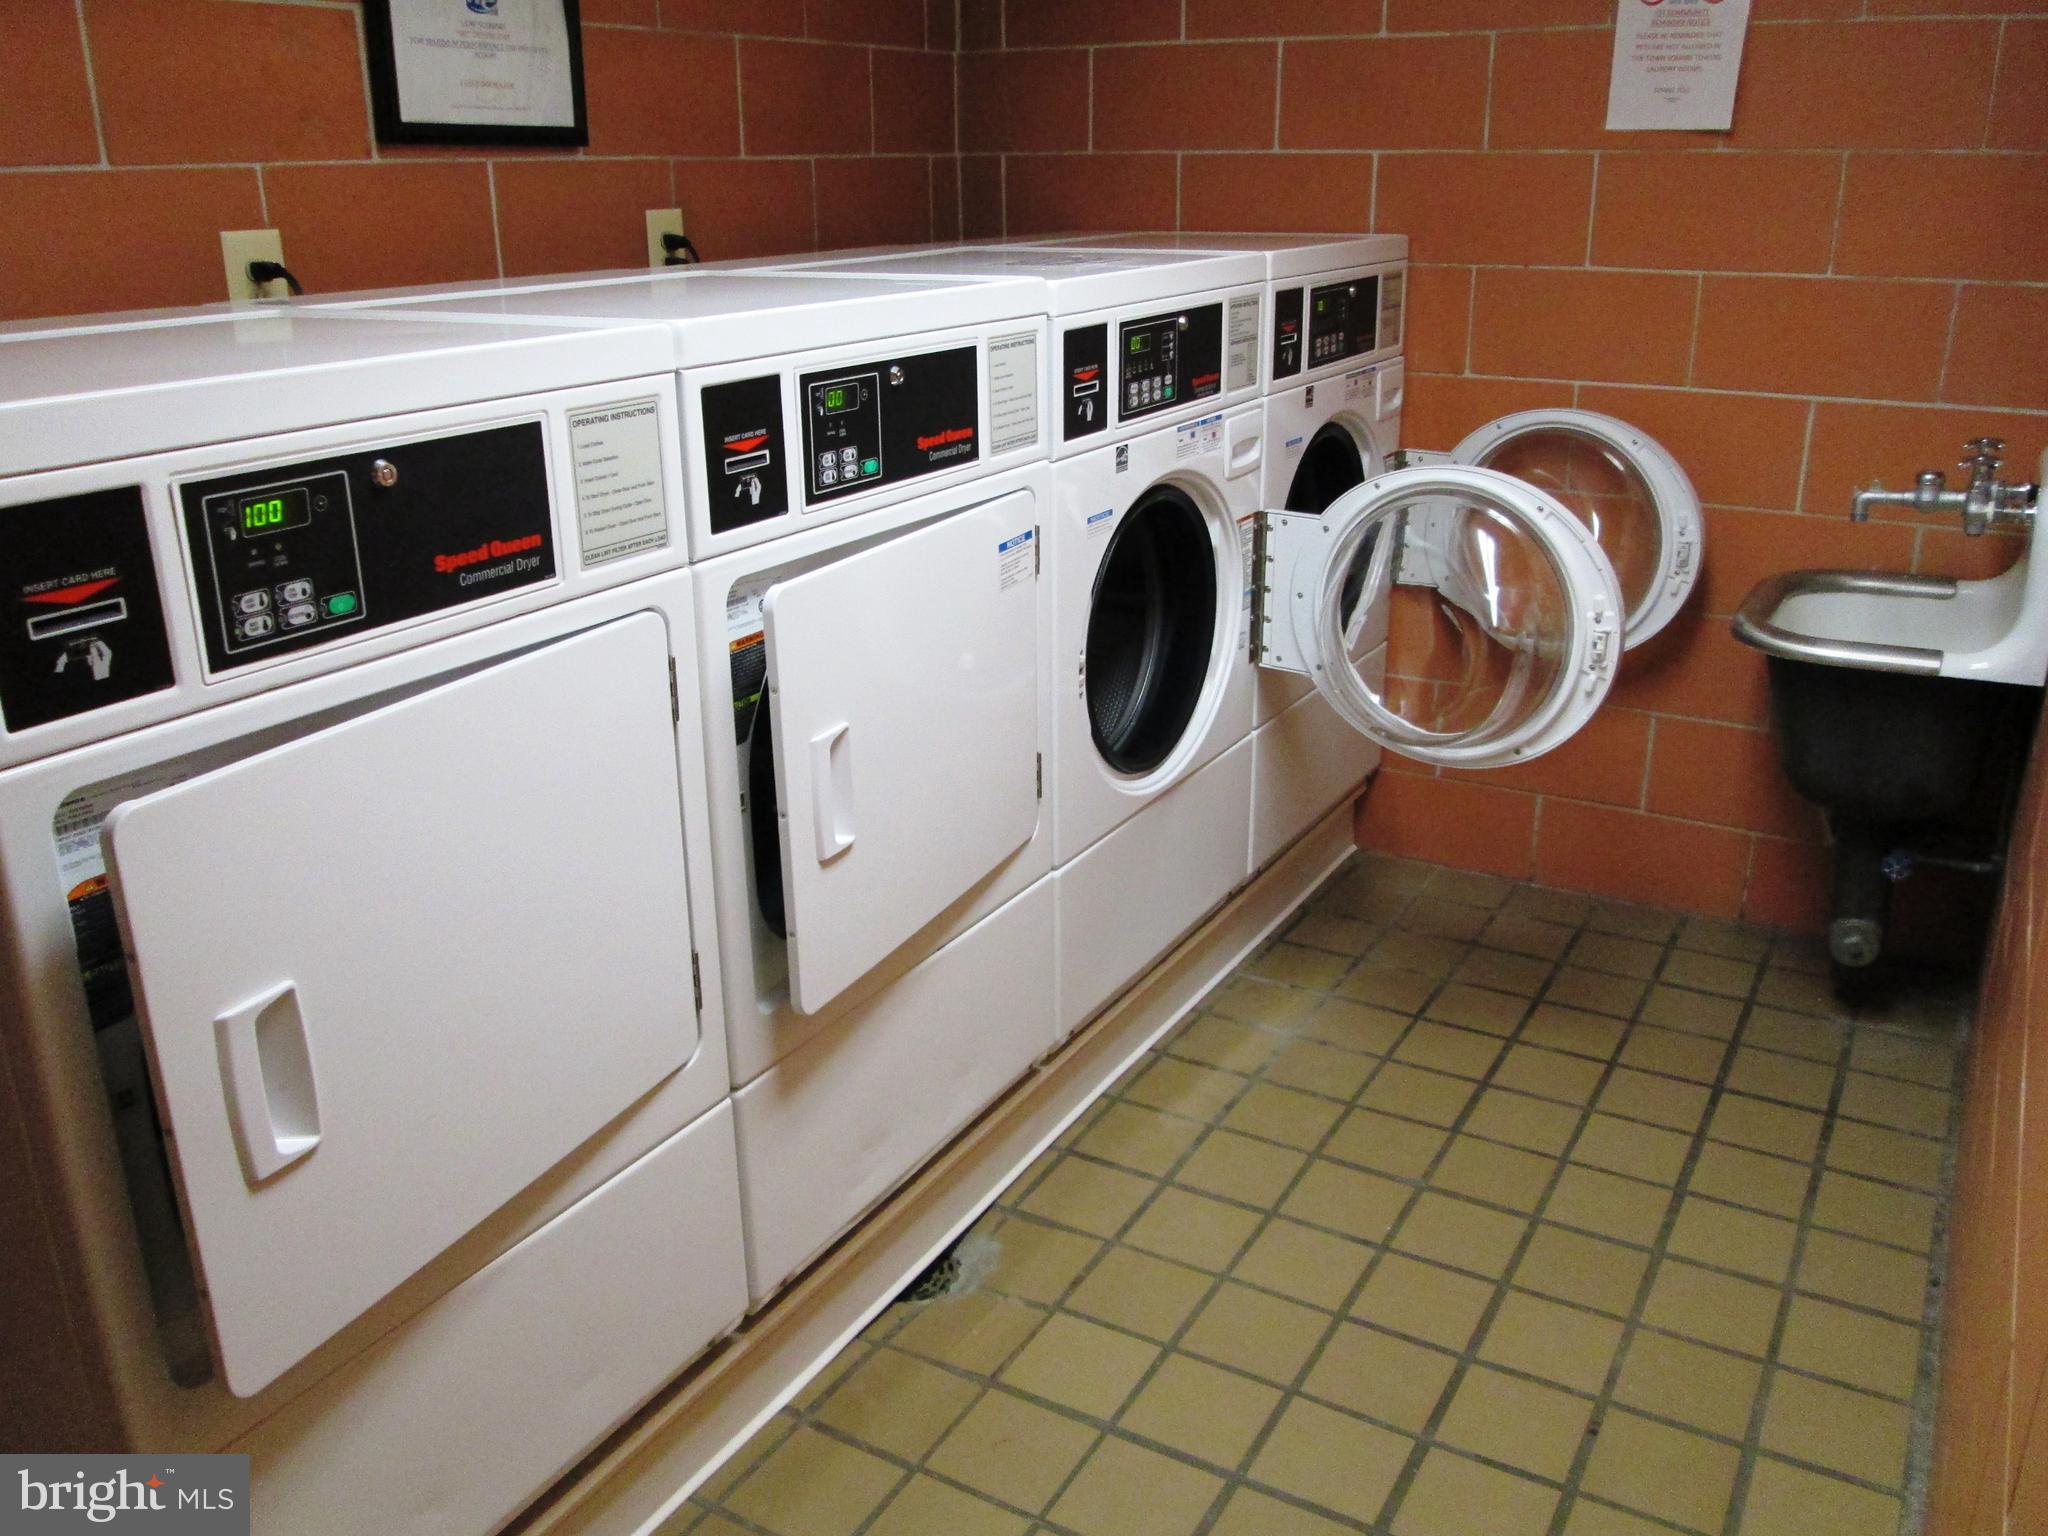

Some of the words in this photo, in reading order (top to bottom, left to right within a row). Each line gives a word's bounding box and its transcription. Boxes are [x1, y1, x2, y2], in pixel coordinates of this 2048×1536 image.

[572, 414, 609, 428] OPERATING
[610, 406, 655, 421] INSTRUCTIONS
[244, 499, 284, 529] 100
[434, 543, 489, 573] Speed
[490, 533, 542, 558] Queen
[22, 580, 58, 594] INSERT
[61, 572, 89, 587] CARD
[90, 566, 117, 580] HERE
[459, 563, 514, 587] Commercial
[516, 555, 542, 573] Dryer
